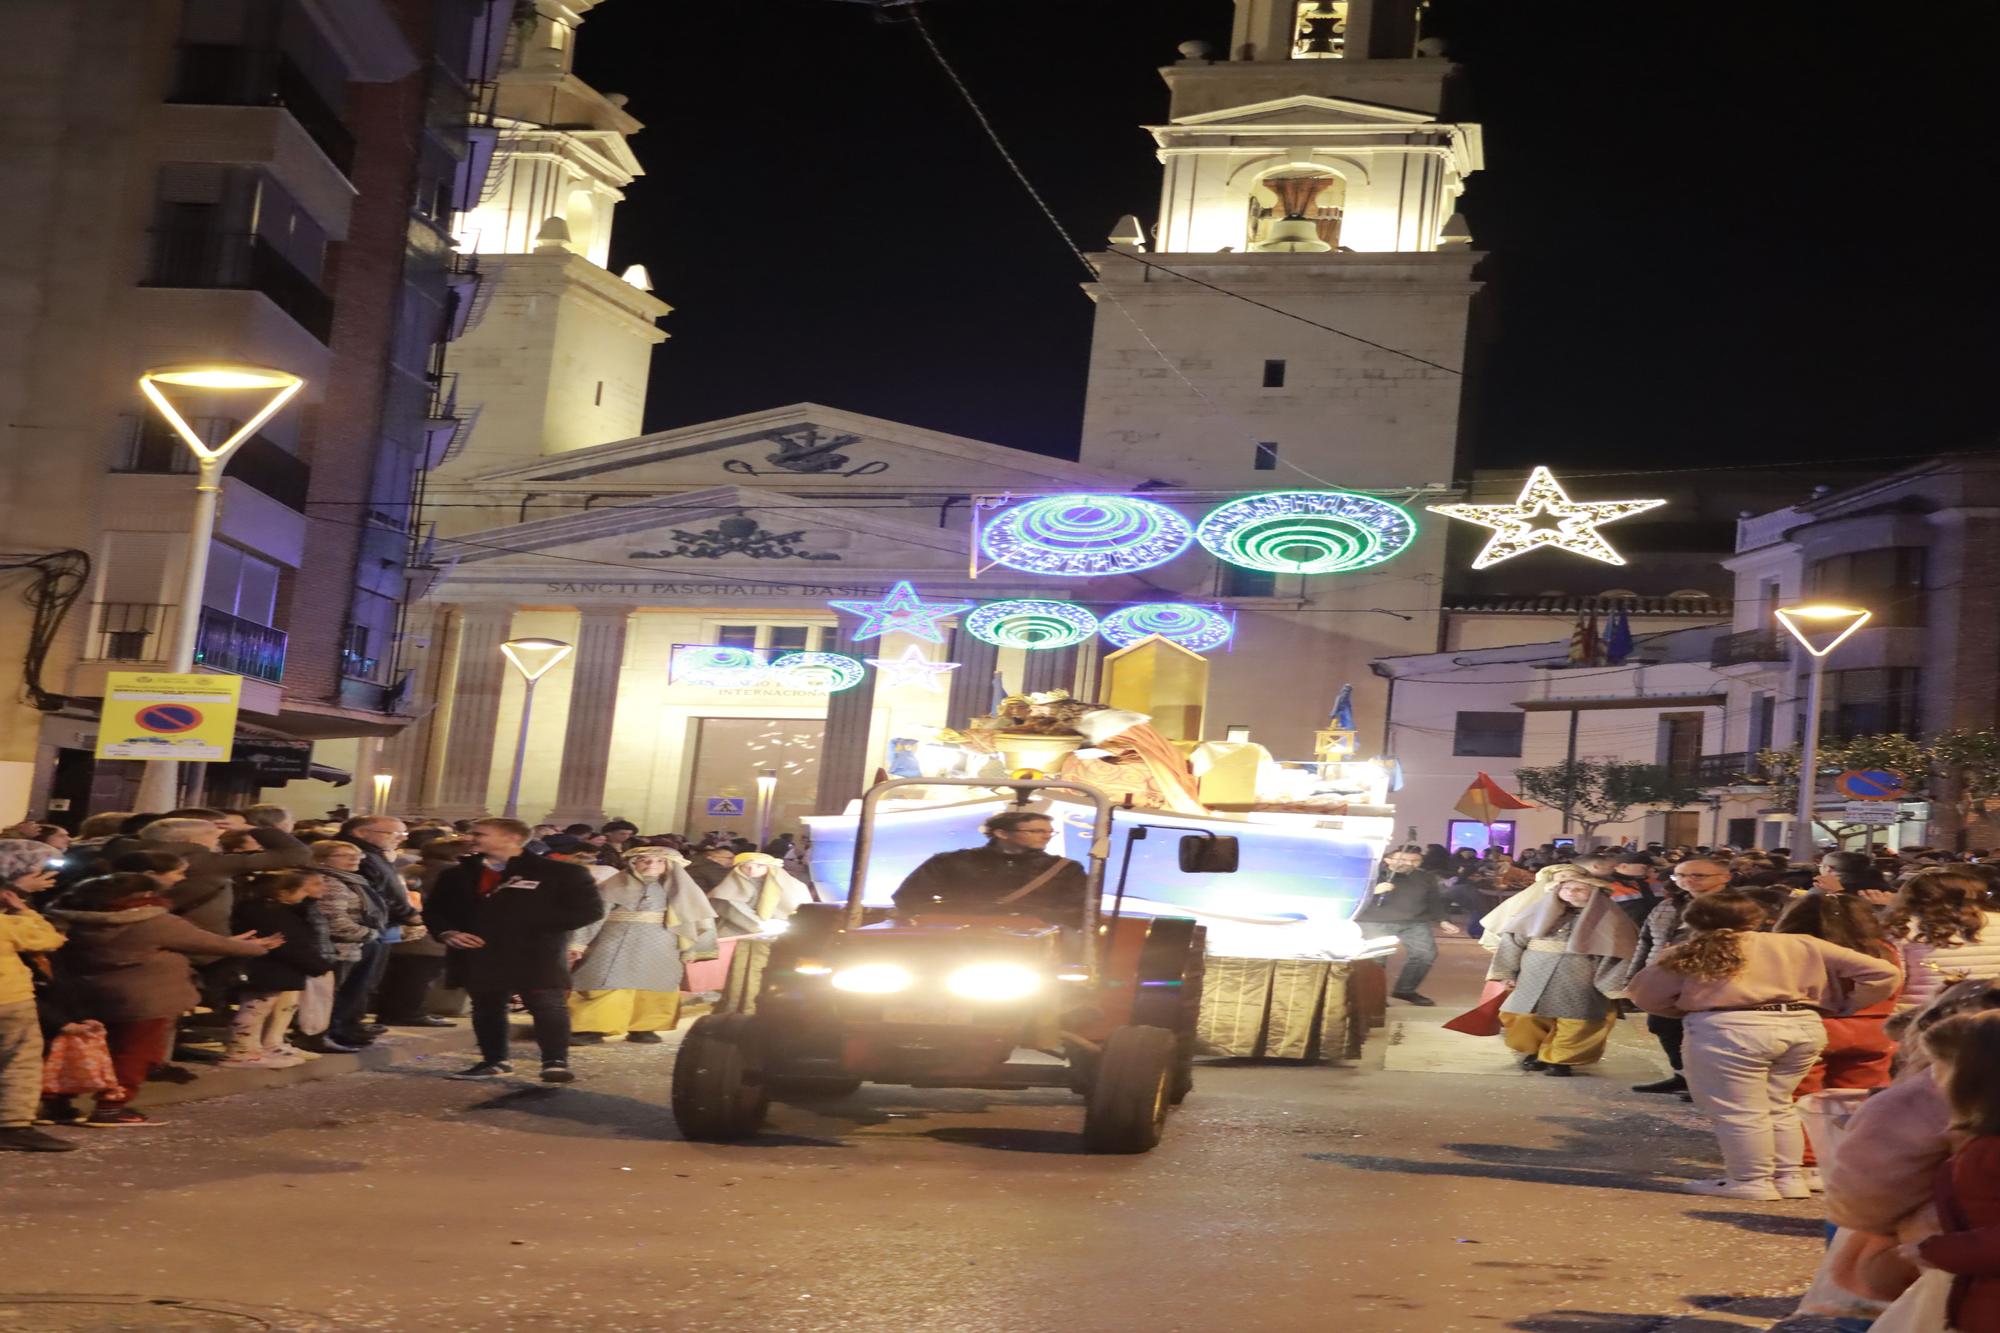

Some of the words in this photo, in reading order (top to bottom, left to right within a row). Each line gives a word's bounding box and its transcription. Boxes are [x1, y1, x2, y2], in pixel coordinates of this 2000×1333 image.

[546, 582, 639, 594] SANCTI
[652, 583, 789, 596] PASCHALIS
[718, 688, 827, 698] INTERNACIONA
